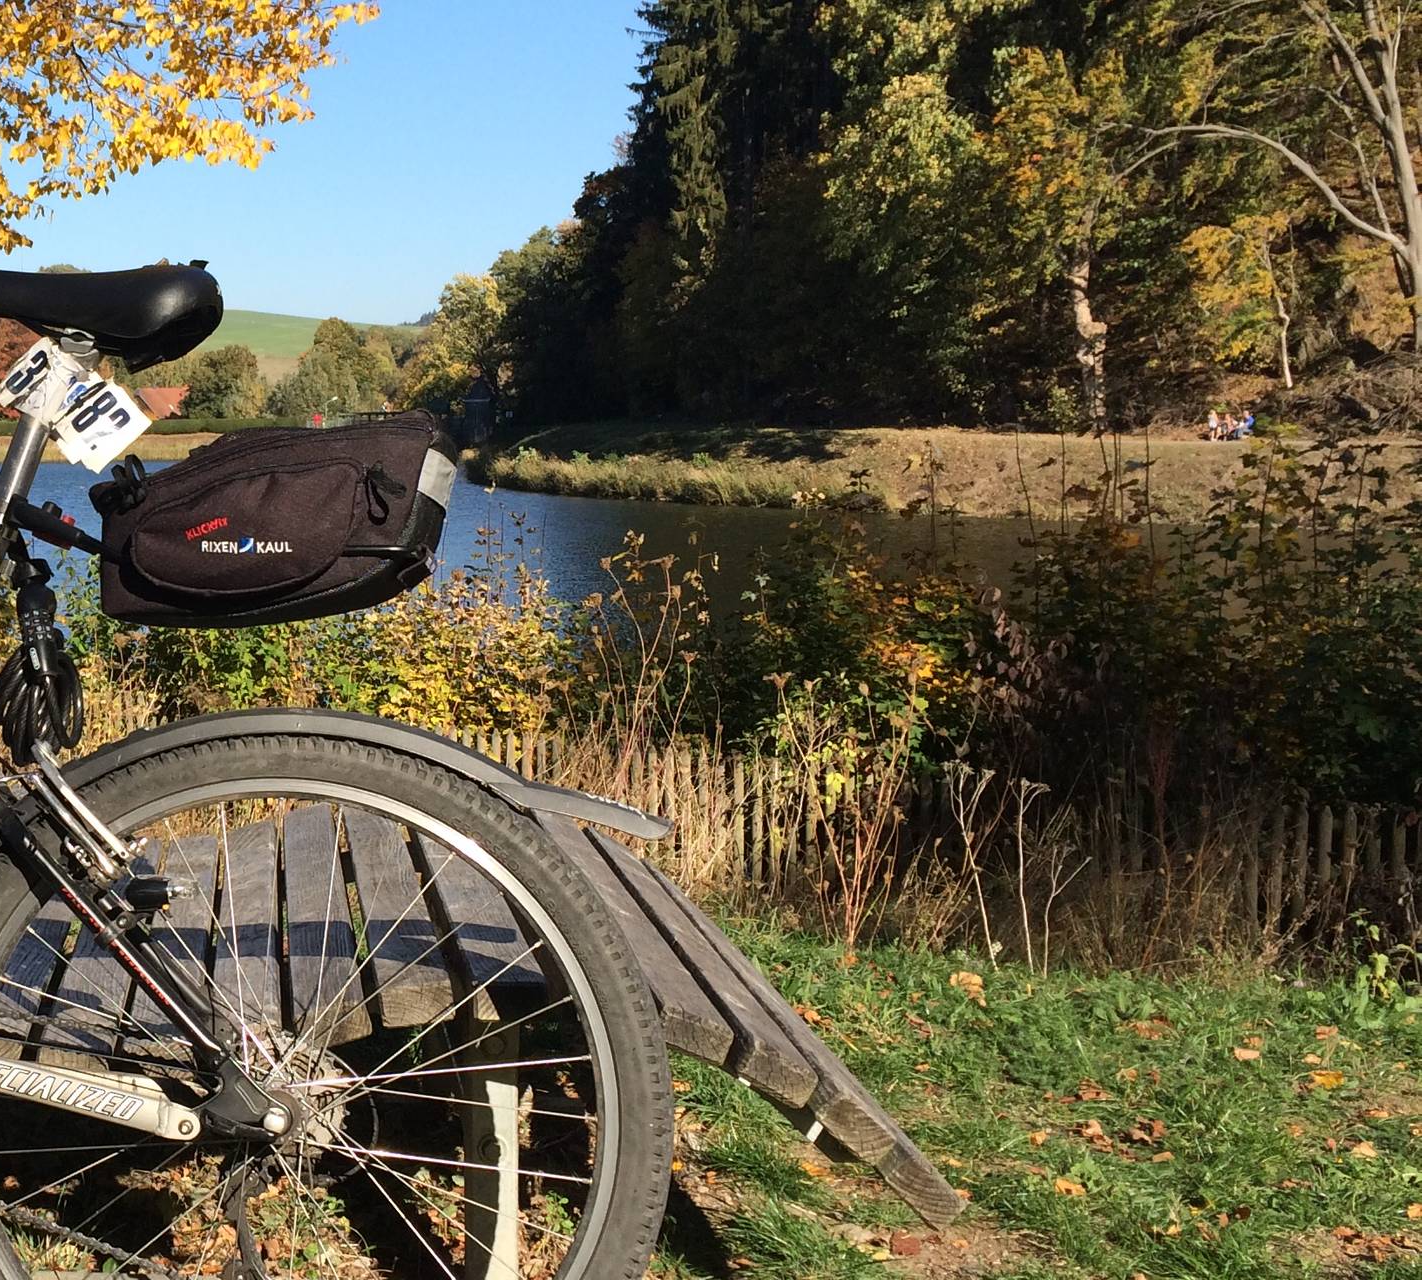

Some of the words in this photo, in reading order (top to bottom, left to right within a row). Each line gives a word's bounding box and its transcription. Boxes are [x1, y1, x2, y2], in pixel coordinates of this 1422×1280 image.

[5, 350, 49, 395] 3
[201, 540, 239, 555] RIXEN
[256, 541, 293, 554] KAUL
